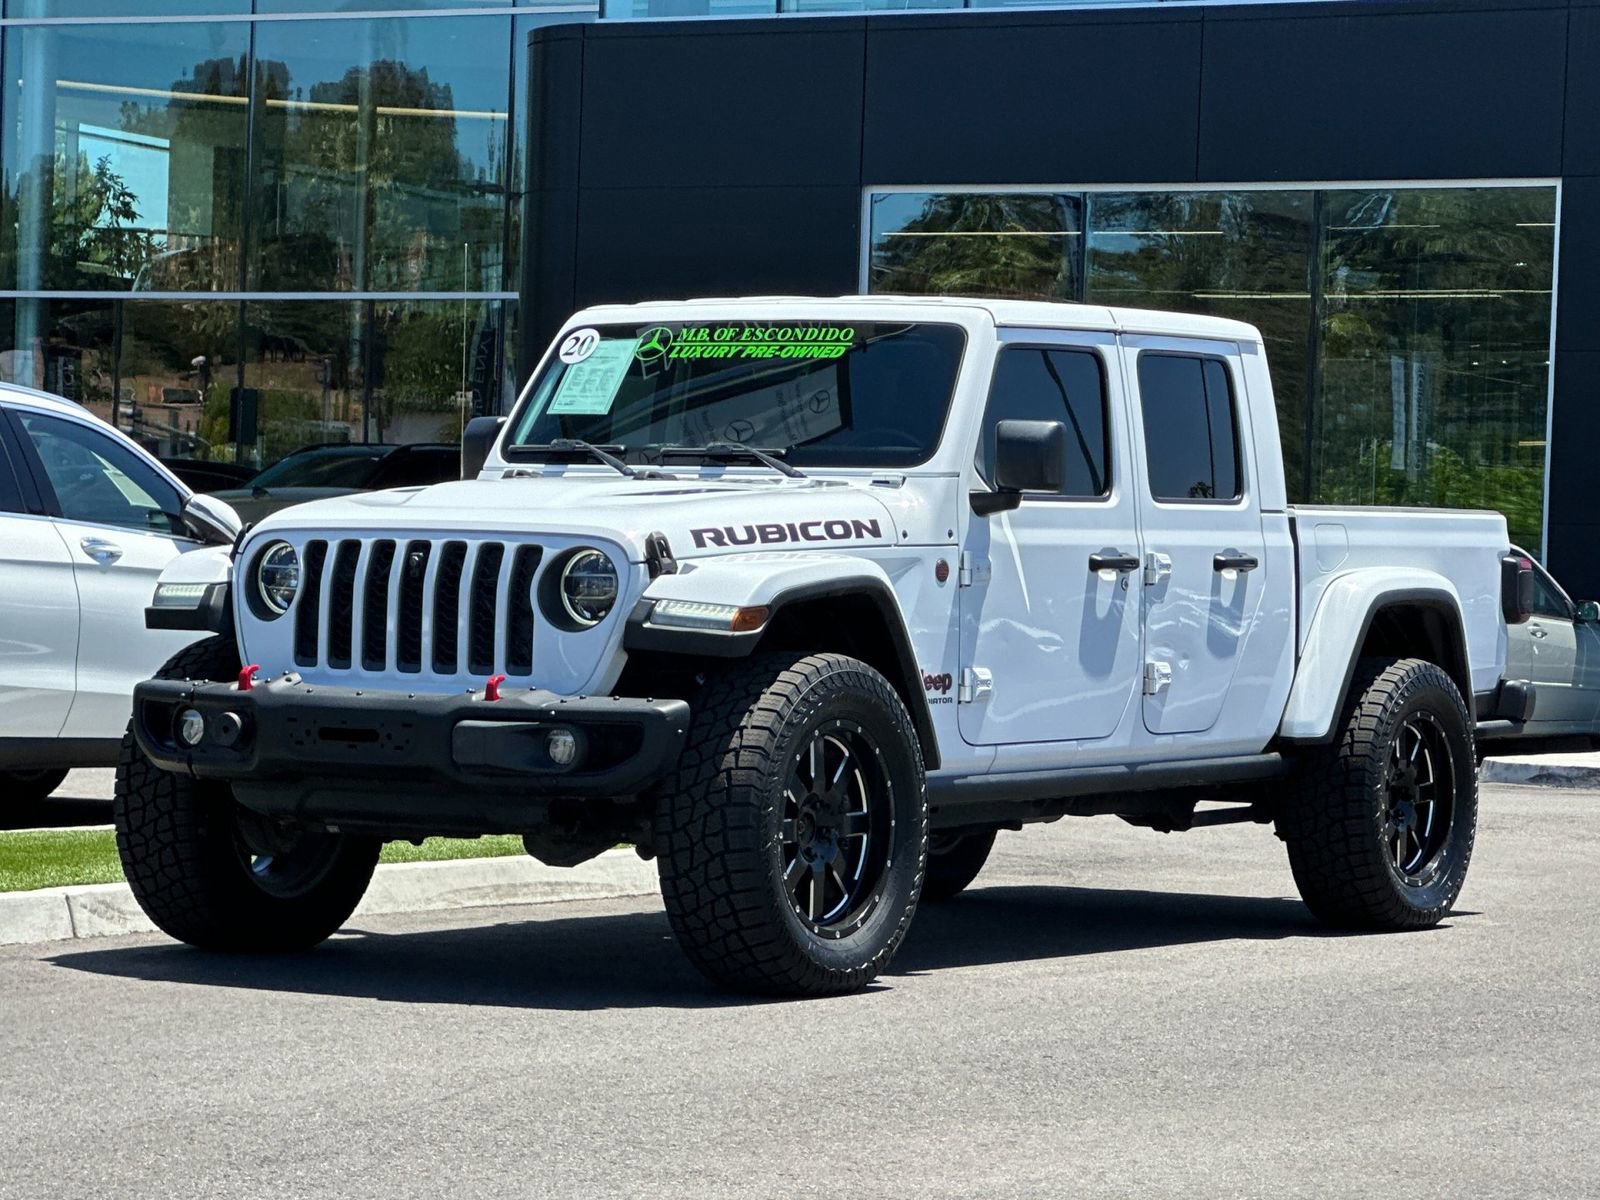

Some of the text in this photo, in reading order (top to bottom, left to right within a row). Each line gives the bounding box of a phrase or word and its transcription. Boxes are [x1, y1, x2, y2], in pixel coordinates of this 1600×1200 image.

[677, 327, 855, 341] M.B. OF ESCONDIDO
[561, 335, 595, 357] 20
[668, 346, 846, 358] LUXURY PRE-OWNED
[690, 519, 882, 548] RUBICON
